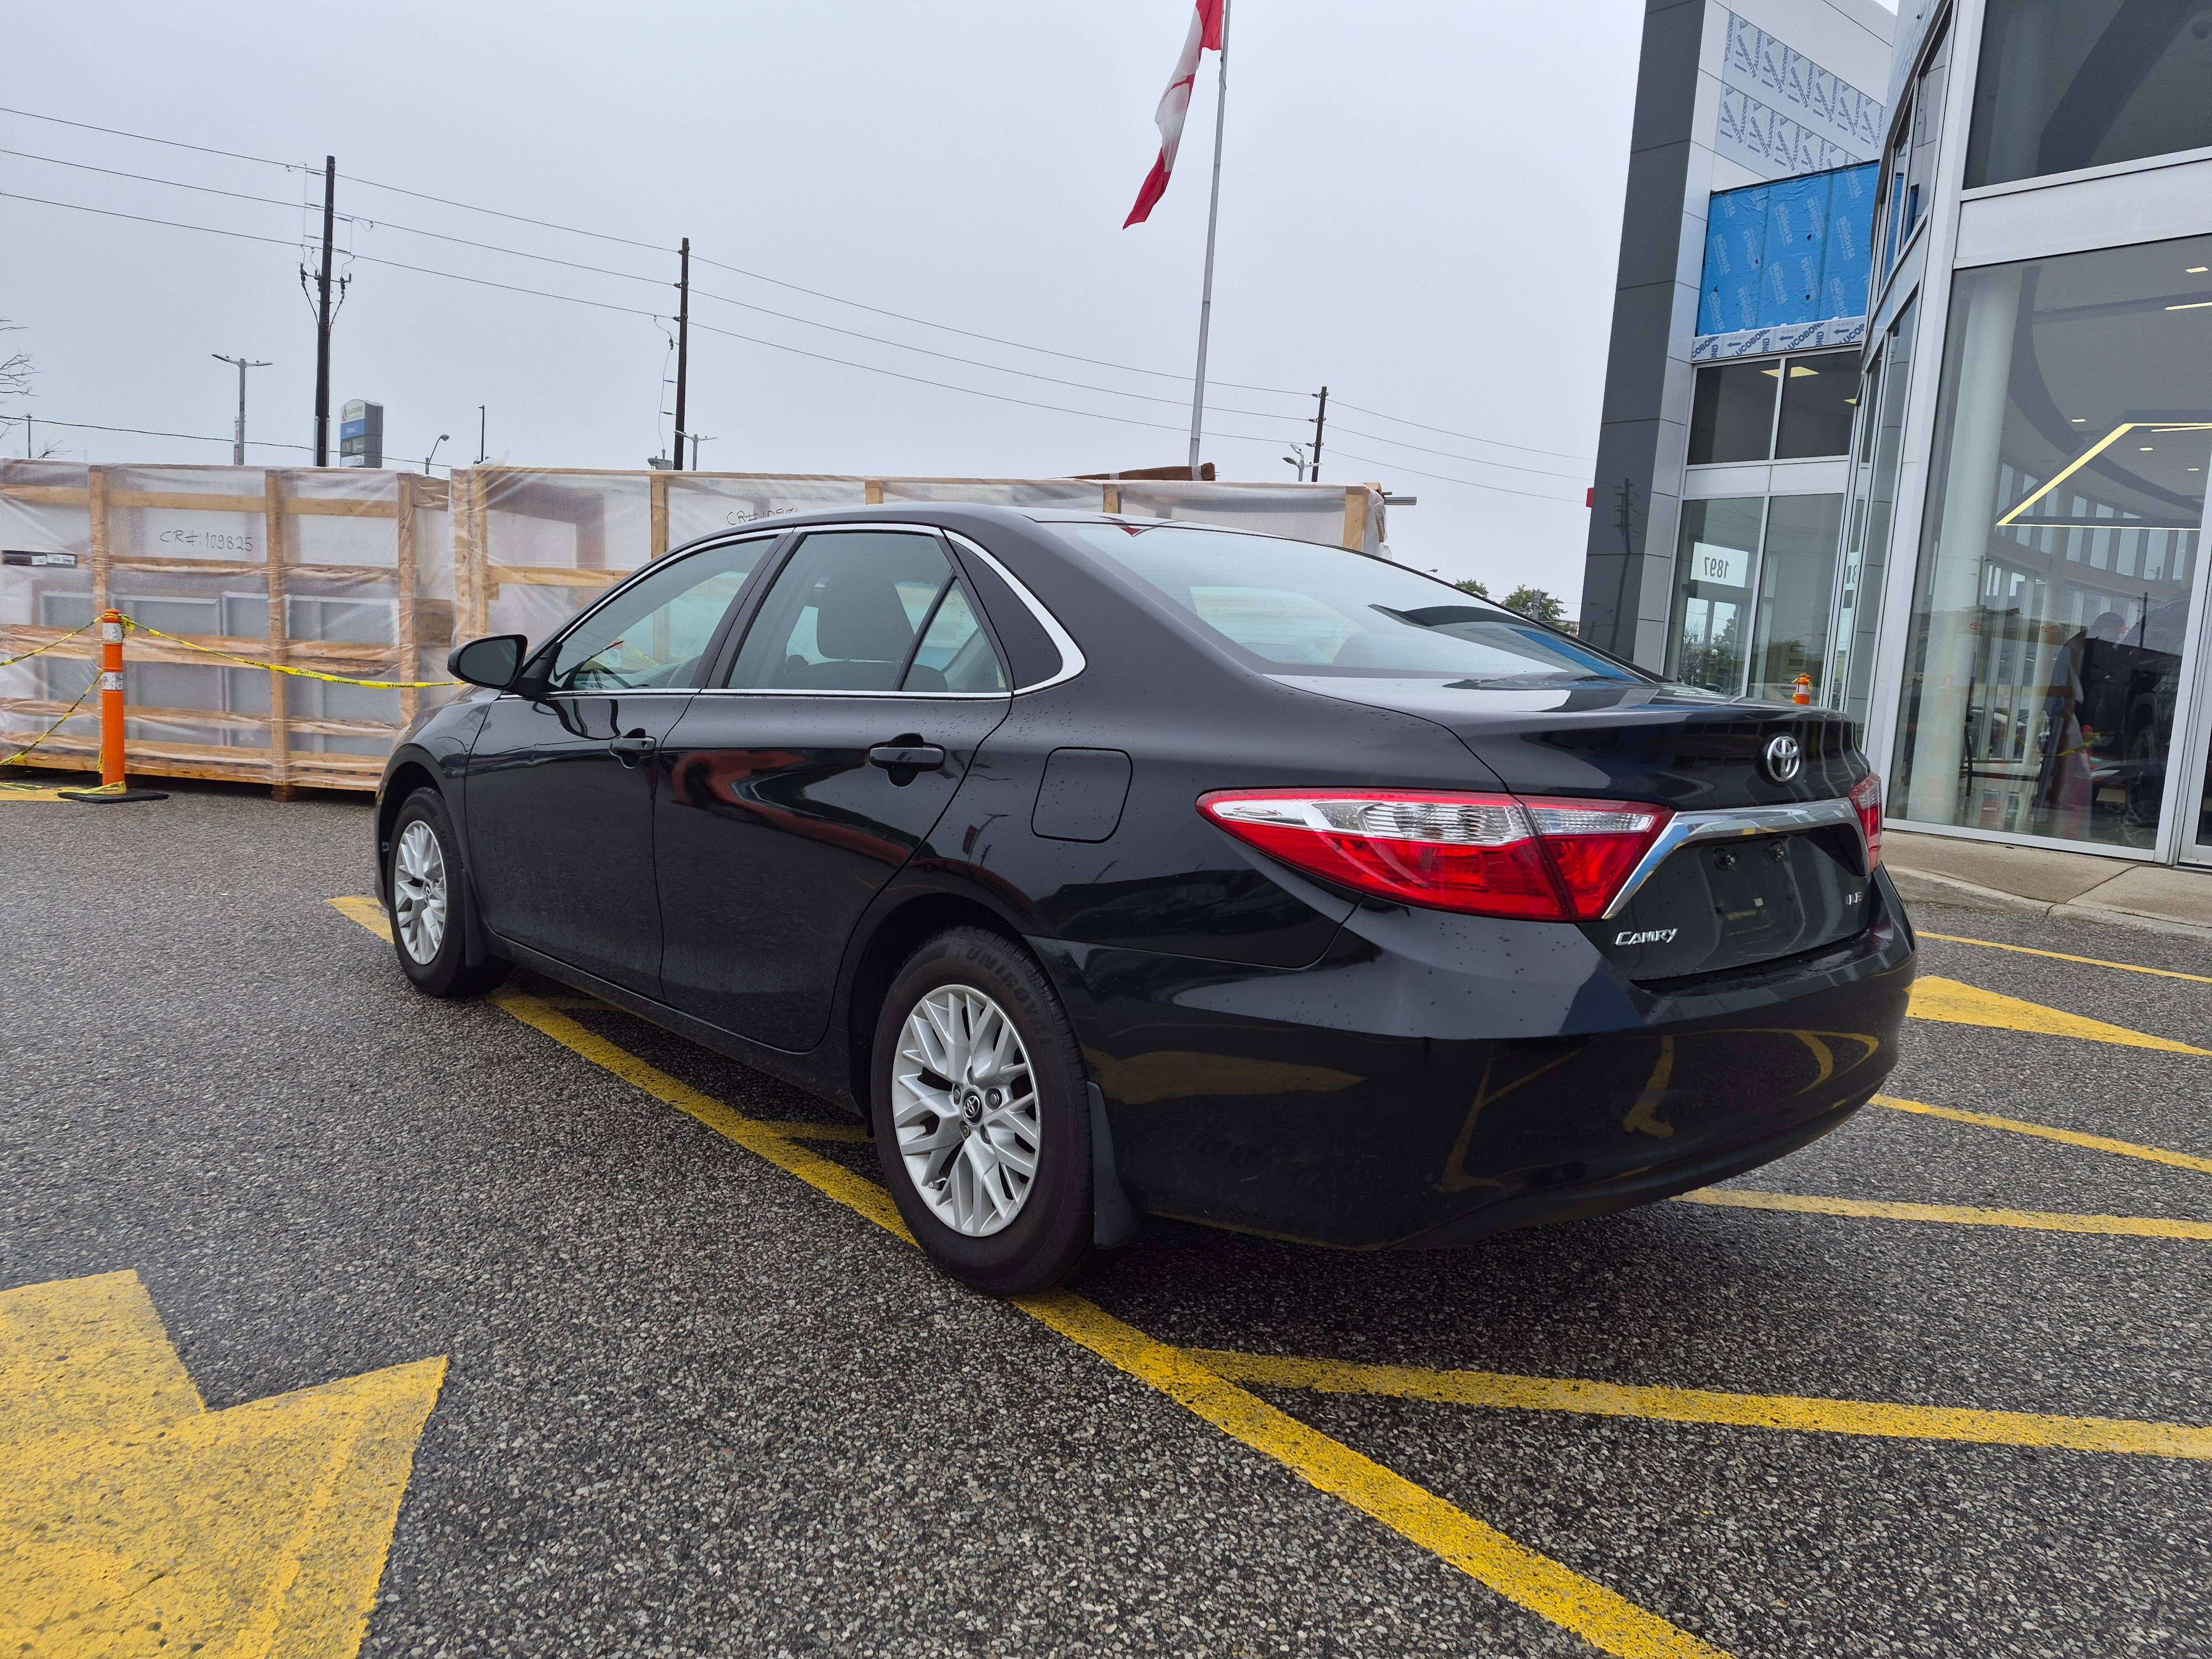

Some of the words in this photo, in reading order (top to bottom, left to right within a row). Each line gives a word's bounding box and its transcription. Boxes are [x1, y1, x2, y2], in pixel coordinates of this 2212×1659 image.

[1737, 35, 1757, 78] ALUCOBOND
[1765, 51, 1783, 93] ALUCOBOND
[1791, 67, 1809, 108] ALUCOBOND
[1816, 82, 1833, 122] ALUCOBOND
[1723, 101, 1743, 144] ALUCOBOND
[1840, 97, 1856, 135] ALUCOBOND
[1863, 111, 1879, 149] ALUCOBOND
[1751, 117, 1770, 158] ALUCOBOND
[1777, 131, 1796, 171] ALUCOBOND
[1615, 928, 1678, 946] CAMRY
[965, 945, 1053, 1052] UNIROYAL
